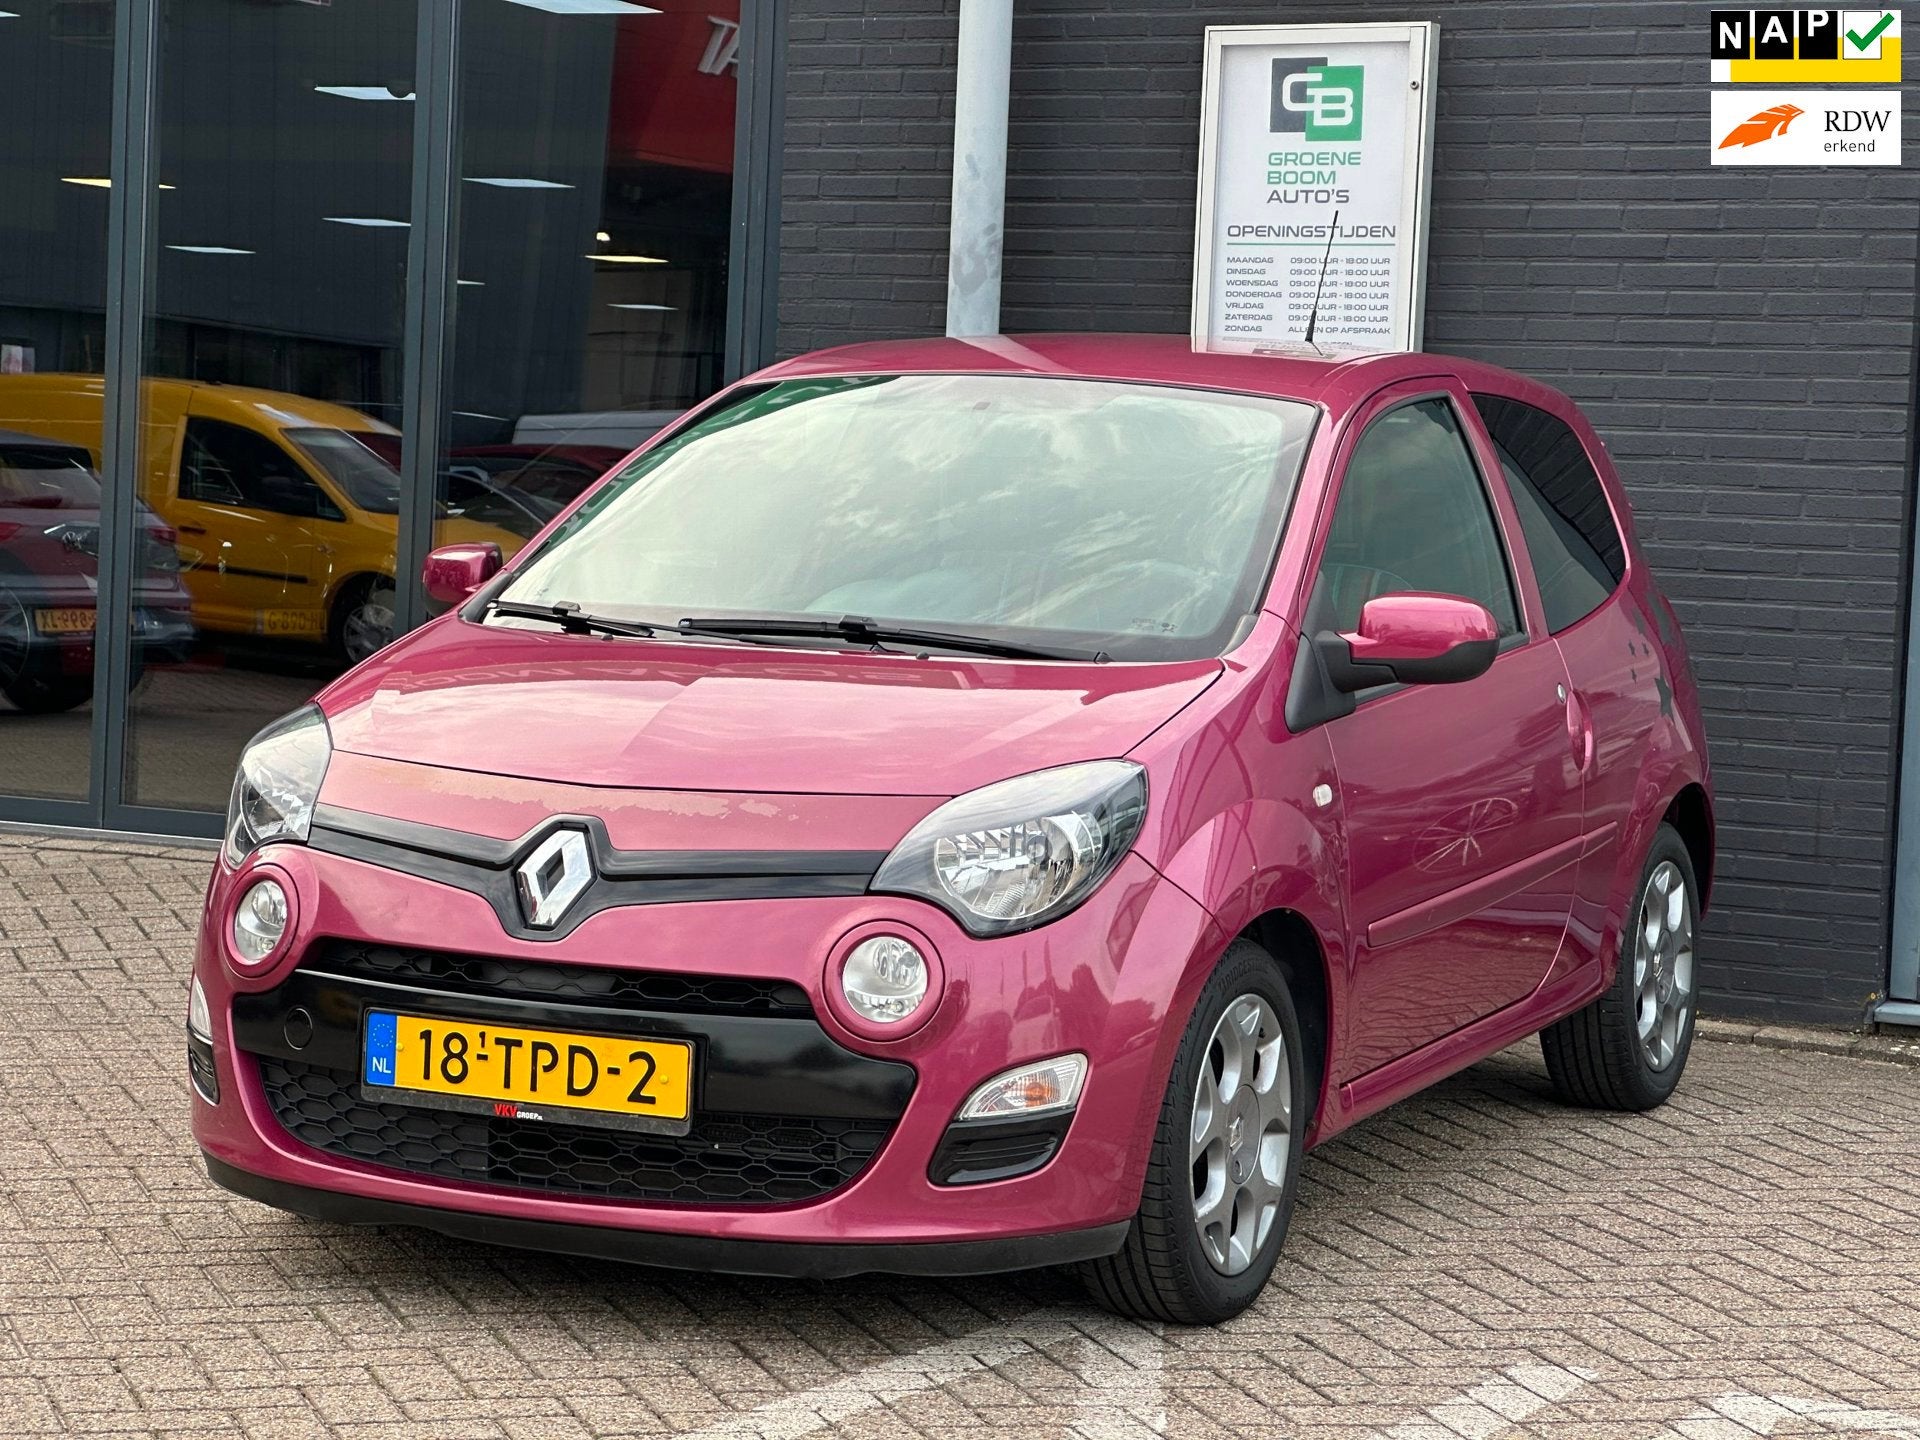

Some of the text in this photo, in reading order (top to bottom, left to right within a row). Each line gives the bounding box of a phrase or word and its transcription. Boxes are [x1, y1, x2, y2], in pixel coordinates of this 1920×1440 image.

[1267, 151, 1362, 166] GROENE
[1266, 170, 1337, 185] BOOM
[1266, 189, 1350, 204] AUTO'S
[1227, 225, 1396, 238] OPENINGSTIJDEN
[1226, 279, 1279, 287] WOENSDAG
[371, 1059, 391, 1074] NL
